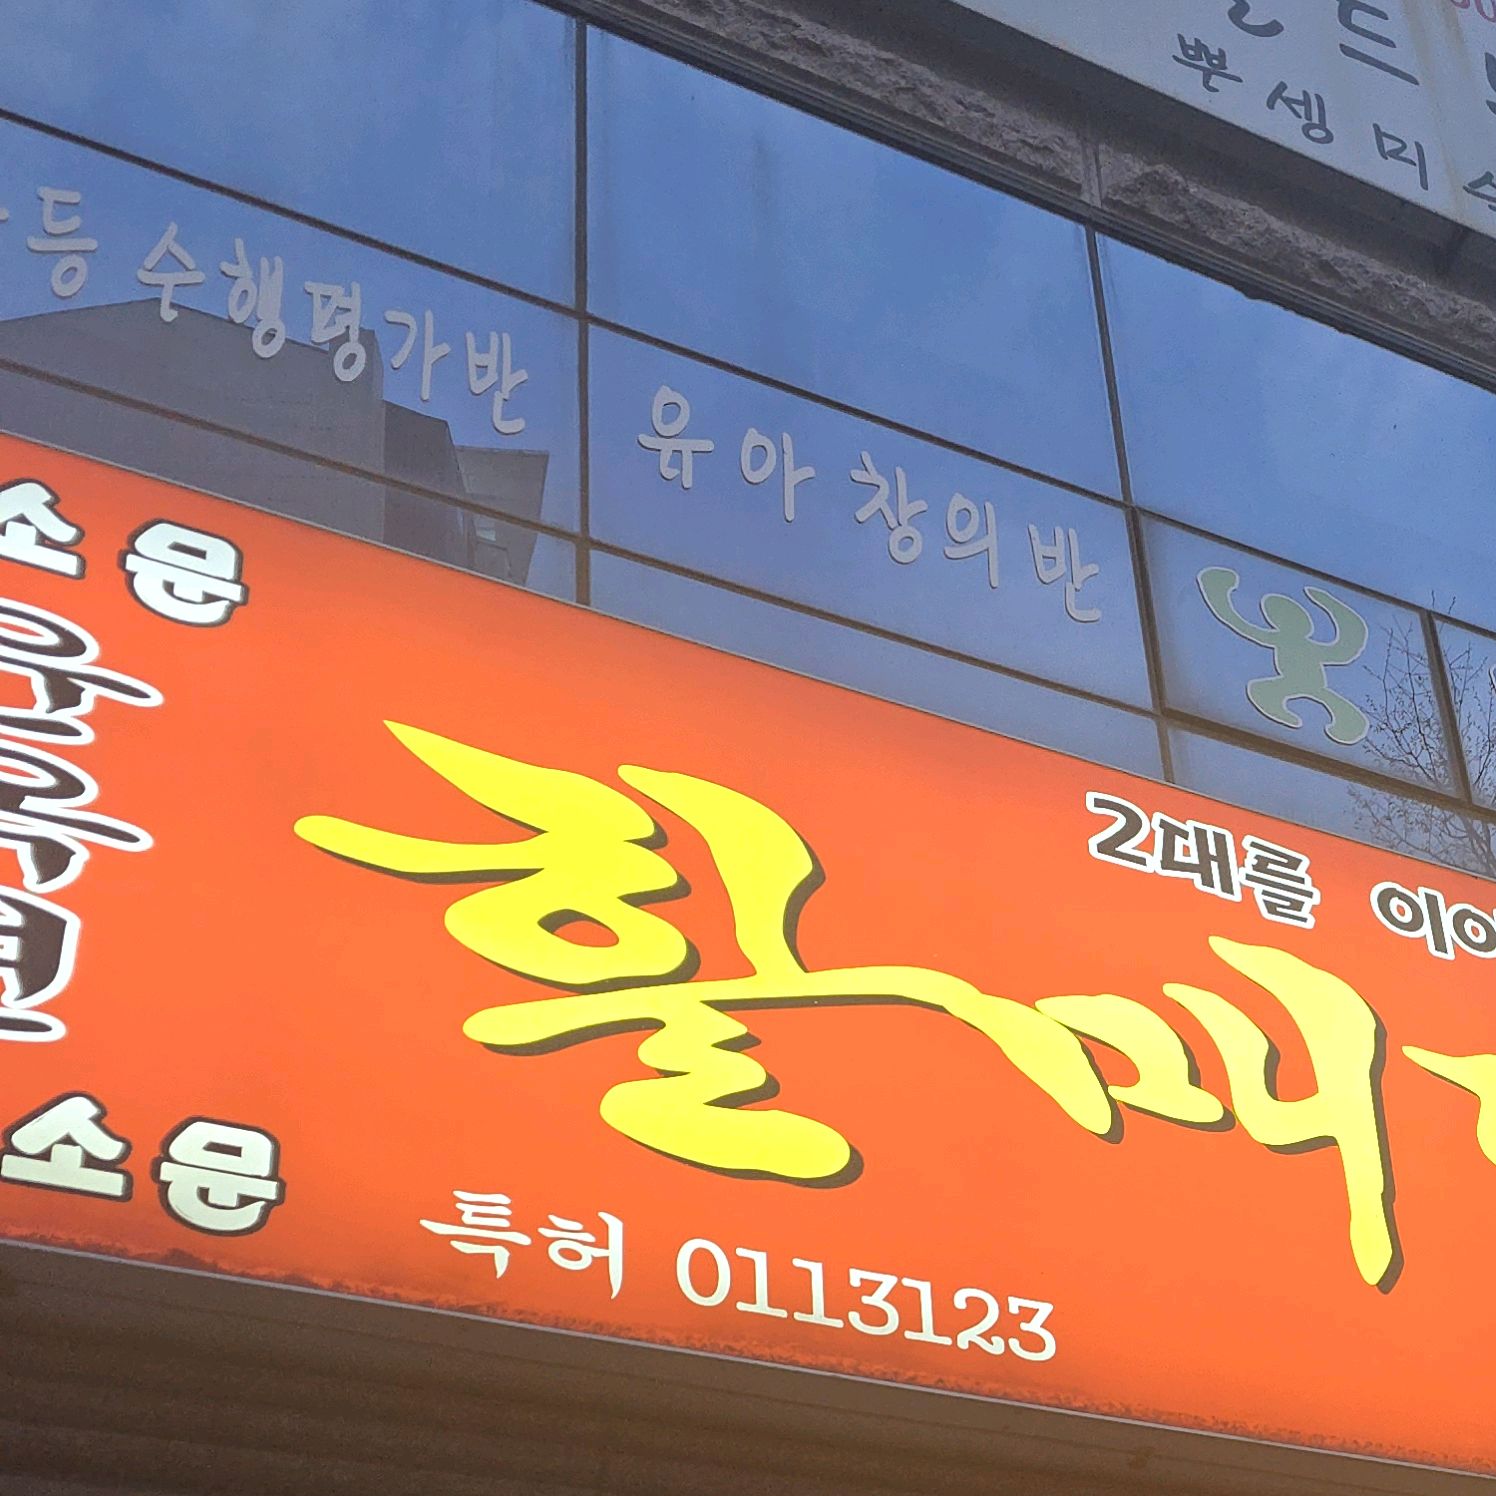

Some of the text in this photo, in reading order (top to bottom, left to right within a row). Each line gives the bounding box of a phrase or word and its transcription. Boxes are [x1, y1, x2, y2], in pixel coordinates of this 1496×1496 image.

[0, 186, 98, 298] 등
[1086, 791, 1322, 929] 2대를
[420, 1190, 1057, 1362] 특허 0113123
